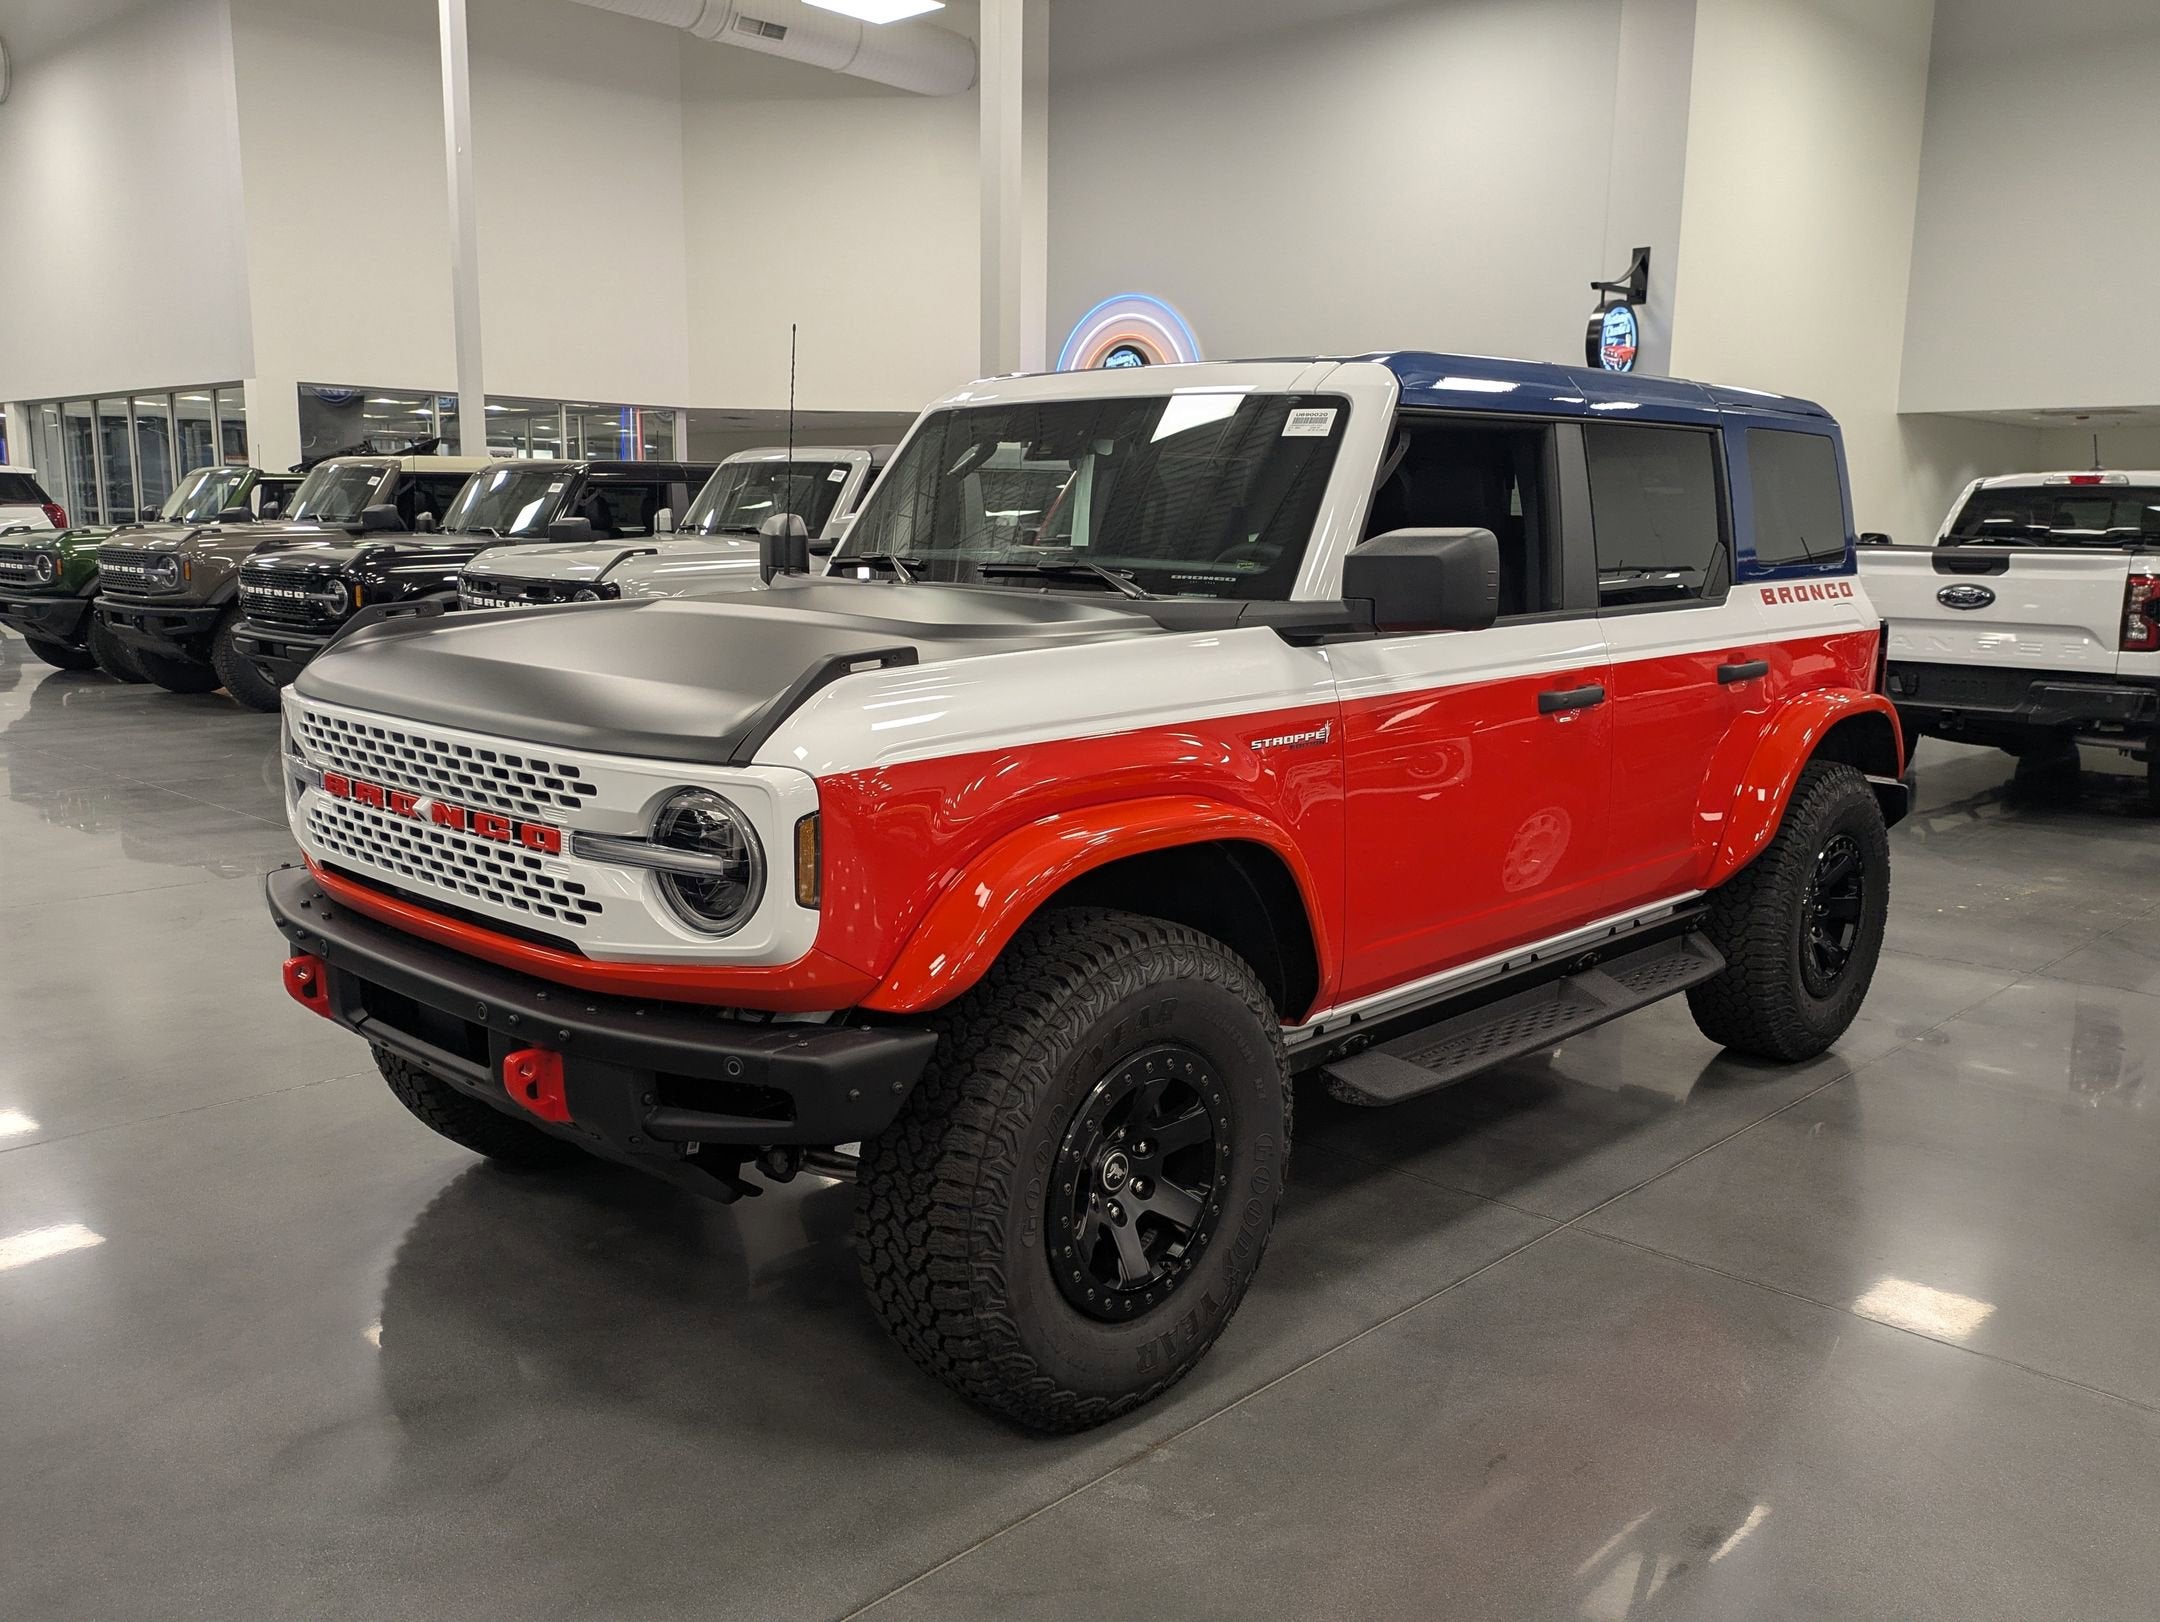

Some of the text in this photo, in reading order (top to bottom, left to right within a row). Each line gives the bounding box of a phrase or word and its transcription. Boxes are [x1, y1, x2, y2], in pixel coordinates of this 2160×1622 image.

[1171, 574, 1237, 582] BRONCO
[247, 586, 305, 599] BRONCO
[1760, 582, 1853, 605] BRONCO
[1251, 730, 1326, 750] STROPPE
[324, 771, 562, 853] BRONCO
